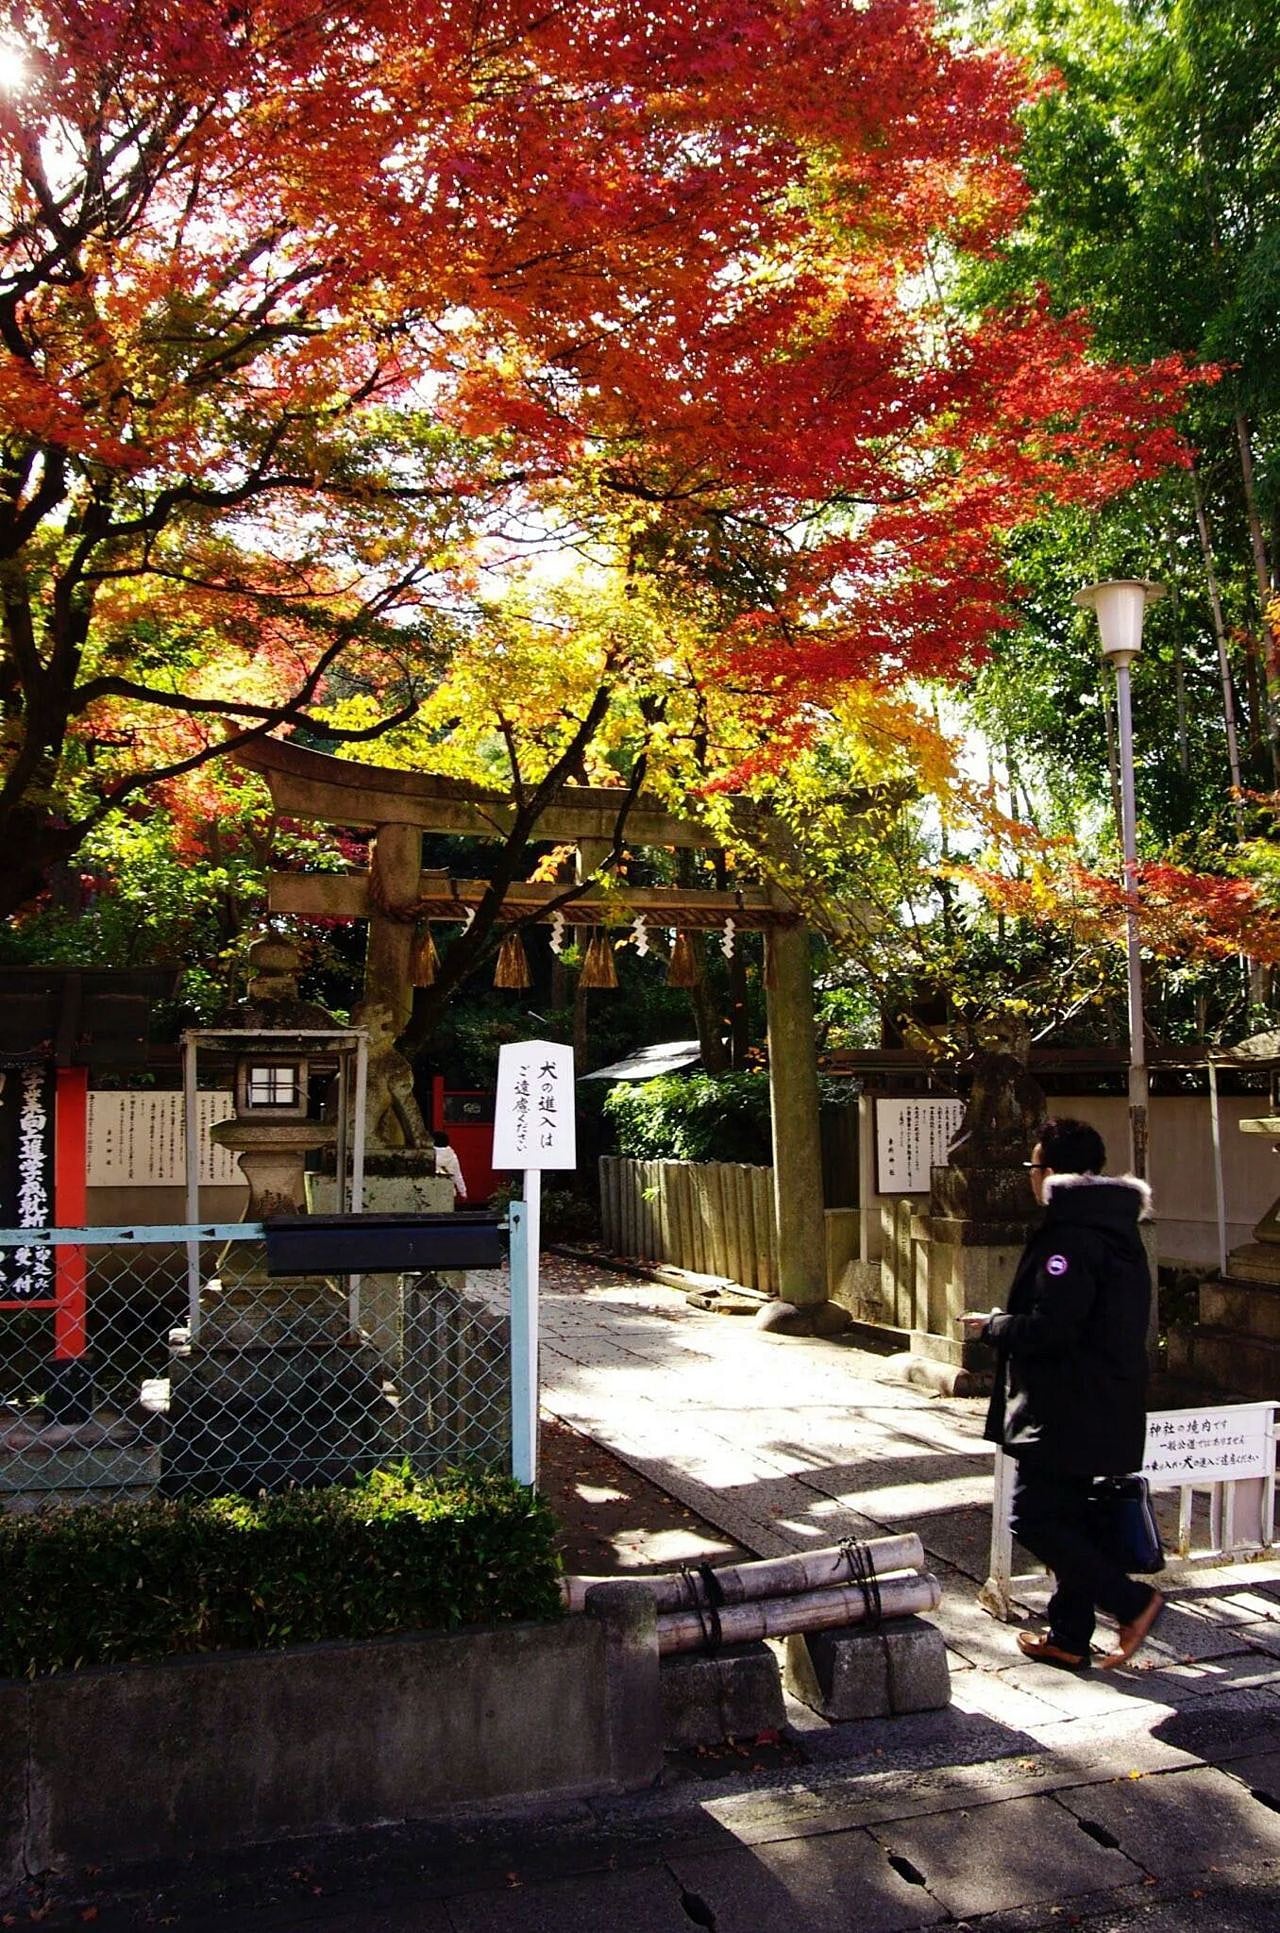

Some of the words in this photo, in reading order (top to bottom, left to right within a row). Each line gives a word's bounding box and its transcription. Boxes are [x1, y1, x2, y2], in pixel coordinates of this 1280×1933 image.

[512, 1065, 532, 1152] ご遠慮ください
[537, 1060, 558, 1148] 犬の進入は
[1149, 1418, 1228, 1438] 神社の境内です
